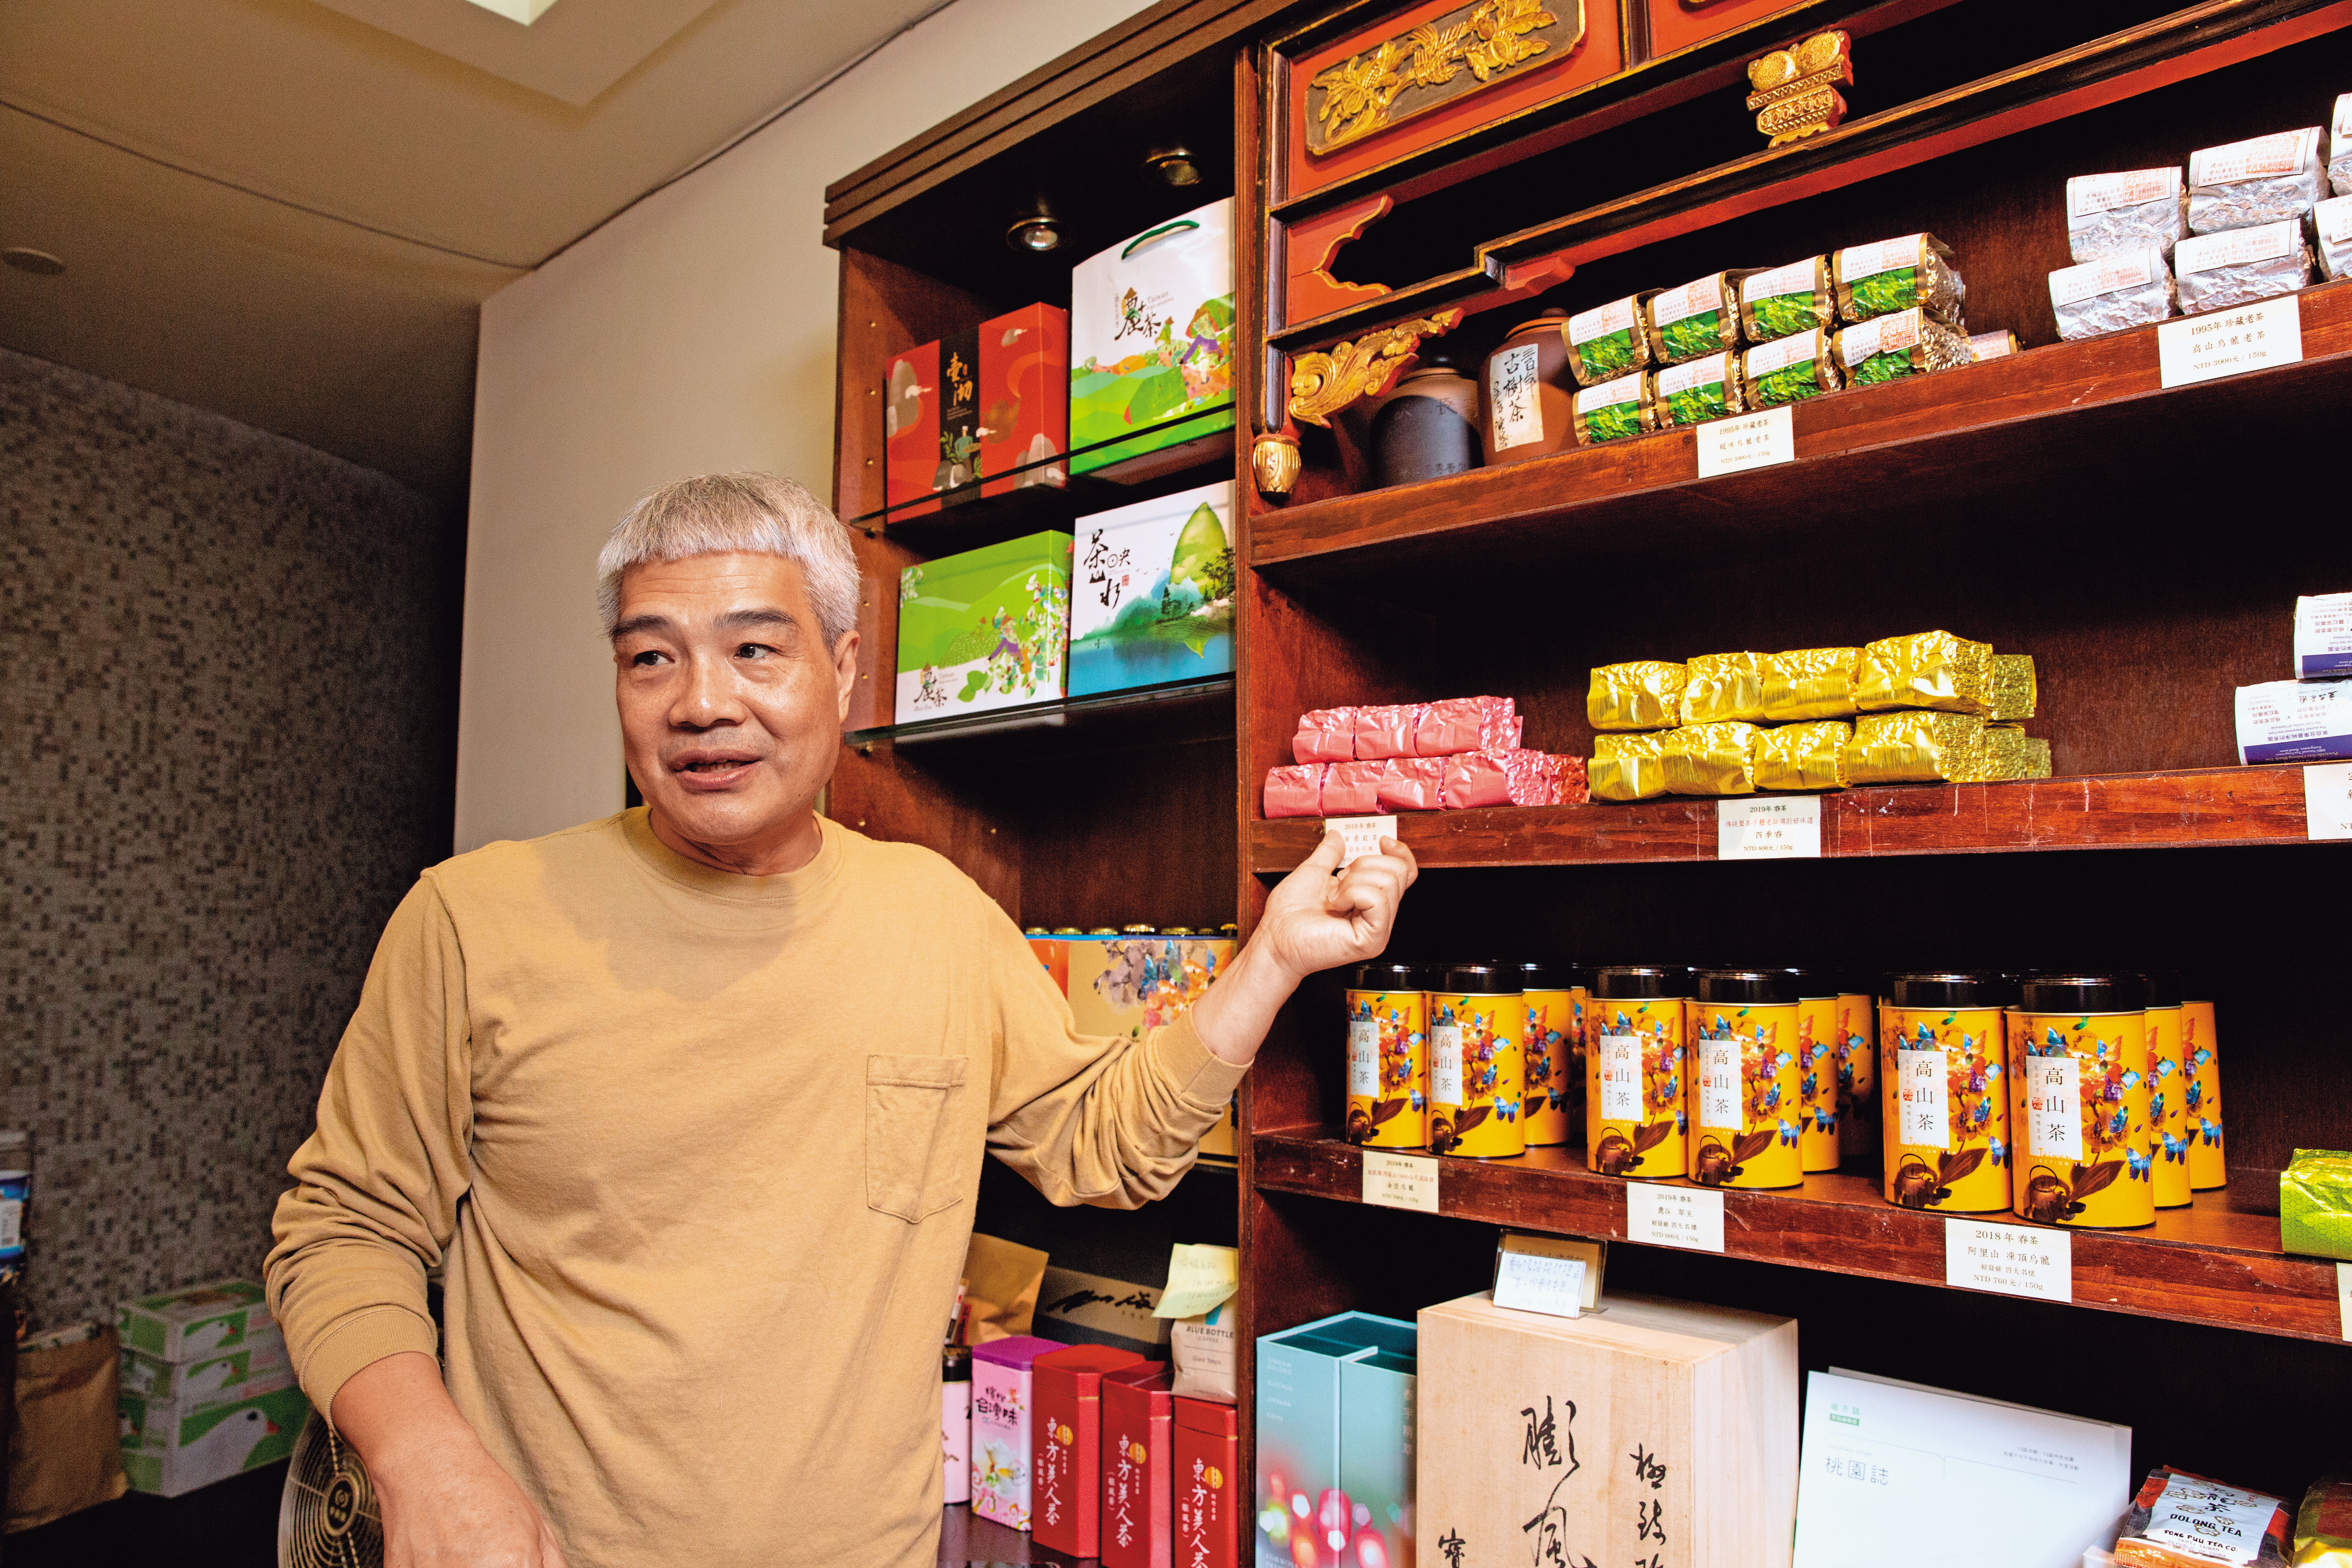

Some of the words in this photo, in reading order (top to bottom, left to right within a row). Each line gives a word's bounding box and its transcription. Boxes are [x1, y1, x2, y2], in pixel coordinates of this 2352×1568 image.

[2192, 322, 2222, 335] 1995年
[2225, 312, 2264, 327] 珍藏老茶
[2192, 331, 2265, 354] 高山烏龍老茶
[2194, 362, 2210, 370] NTD
[2213, 356, 2239, 367] 3000元
[2248, 351, 2267, 360] 150g
[1719, 425, 1741, 435] 1995年
[1743, 419, 1769, 430] 珍藏老茶
[1755, 830, 1783, 839] 四季春
[1358, 1029, 1369, 1084] 高山茶
[1440, 1034, 1452, 1092] 高山茶
[1614, 1044, 1630, 1107] 高山茶
[1713, 1049, 1729, 1114] 高山茶
[1915, 1060, 1934, 1131] 高山茶
[2045, 1067, 2066, 1142] 高山茶
[1976, 1229, 2001, 1241] 2018
[2017, 1234, 2039, 1245] 春茶
[1968, 1246, 1999, 1259] 阿里山
[1973, 1274, 1991, 1283] NTD
[1993, 1277, 2007, 1285] 760
[2025, 1281, 2043, 1291] 150g
[1186, 1325, 1204, 1335] BLUE
[1206, 1328, 1234, 1339] BOTTLE
[1044, 1416, 1062, 1526] 東方美人茶
[1824, 1455, 1889, 1486] 桃園誌
[1115, 1434, 1134, 1548] 東方美人茶
[1189, 1457, 1211, 1568] 東方美人茶
[2170, 1513, 2216, 1529] OOLONG
[2221, 1525, 2242, 1537] TEA
[2168, 1540, 2195, 1551] REPUBLIC
[2187, 1535, 2204, 1544] PUU
